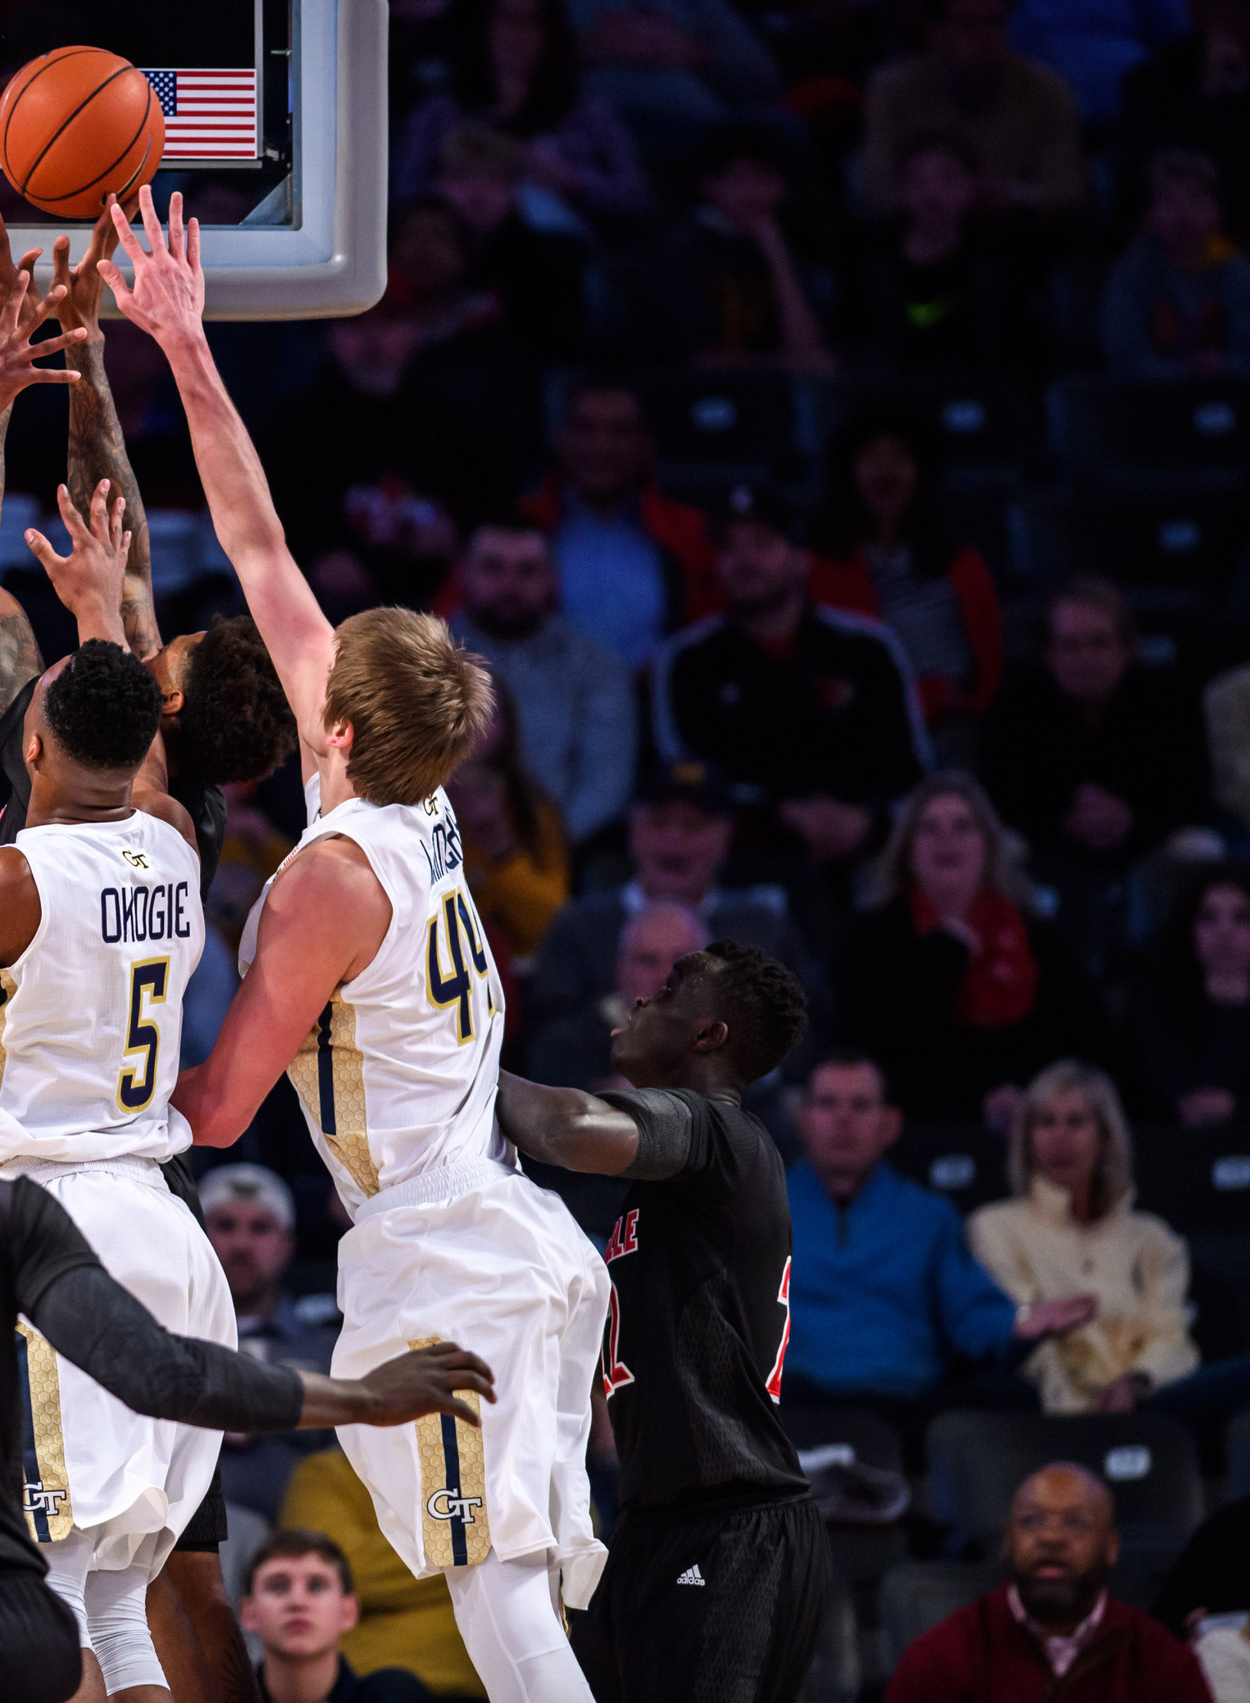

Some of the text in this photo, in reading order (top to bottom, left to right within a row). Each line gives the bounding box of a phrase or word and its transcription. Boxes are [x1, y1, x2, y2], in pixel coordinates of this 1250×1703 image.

[122, 850, 149, 869] GT
[100, 880, 190, 943] OKOGIE
[116, 955, 171, 1114] 5
[427, 1488, 482, 1523] GT
[676, 1577, 705, 1586] adidas
